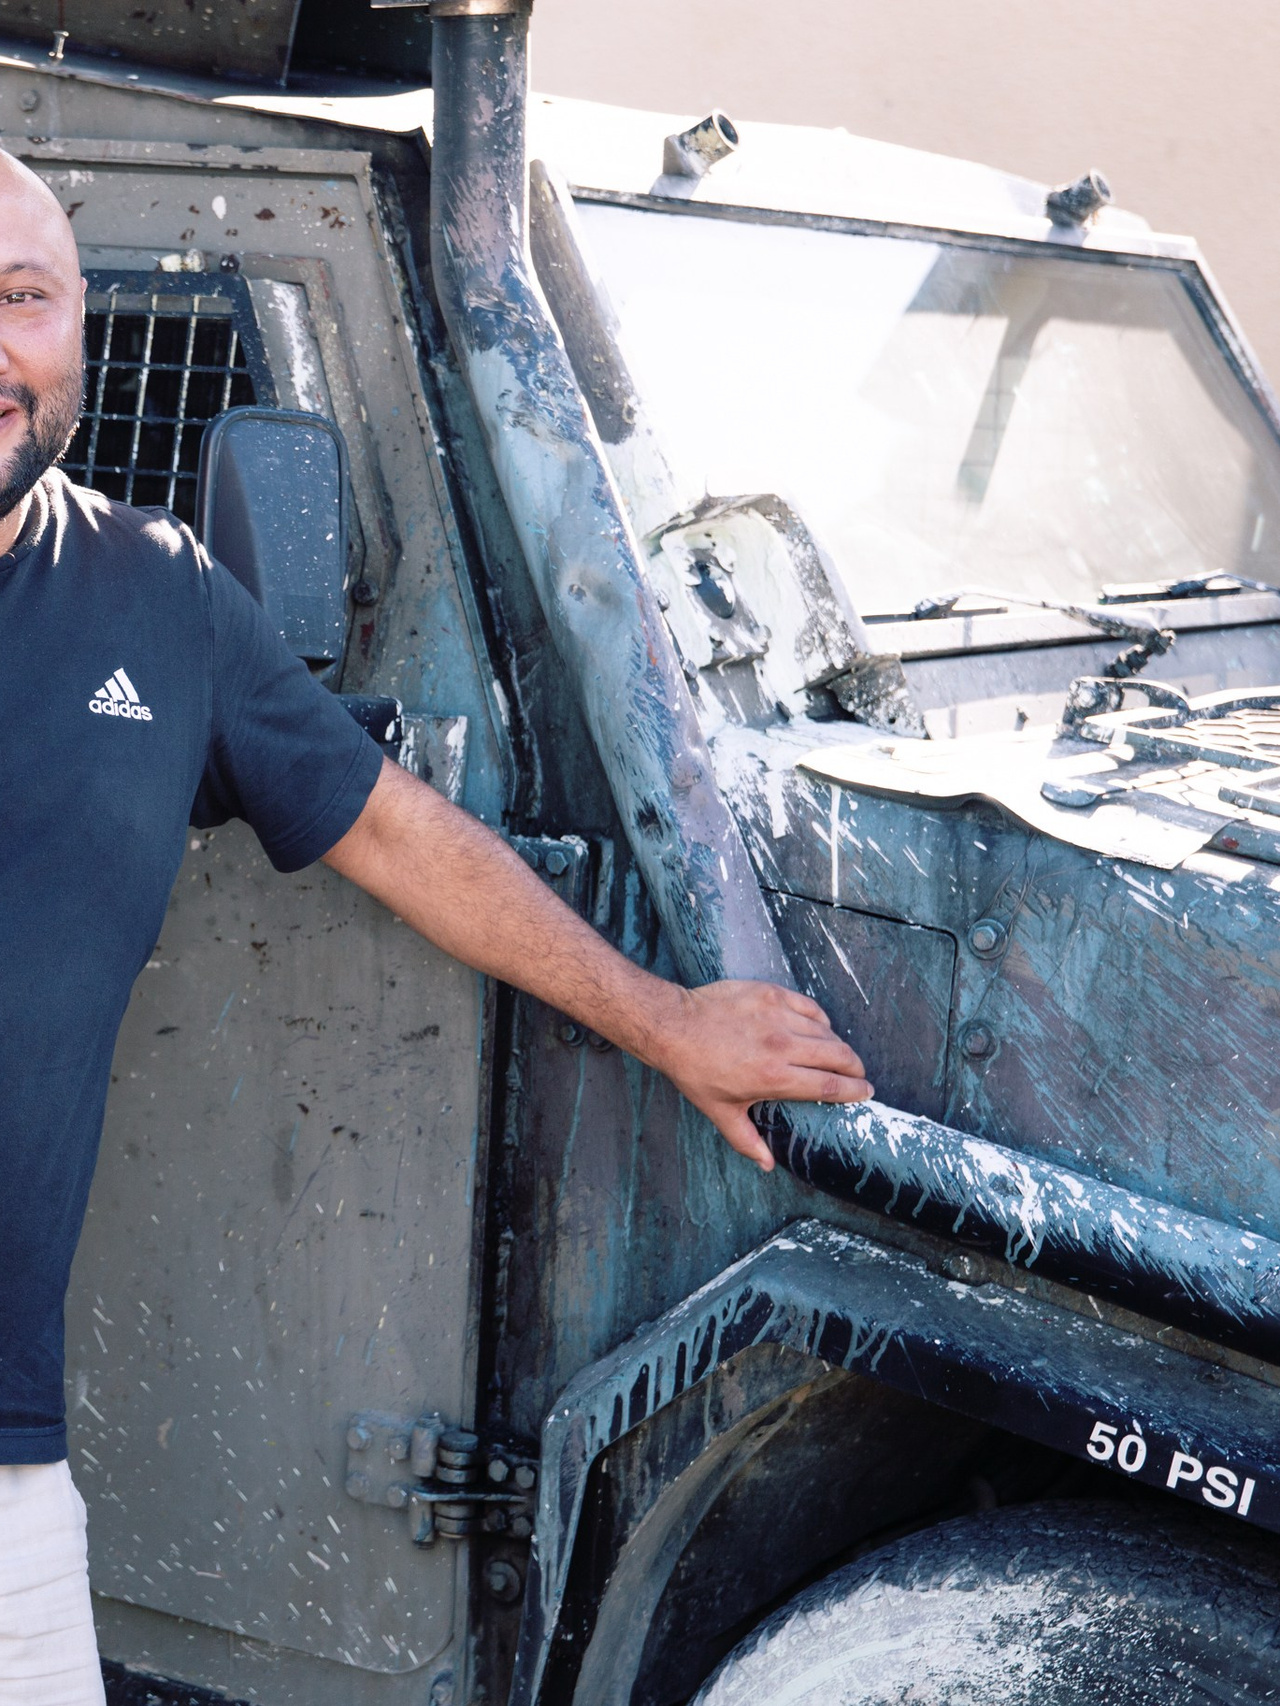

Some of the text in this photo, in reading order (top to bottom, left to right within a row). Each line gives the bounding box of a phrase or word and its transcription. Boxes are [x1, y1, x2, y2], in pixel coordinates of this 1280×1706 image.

[88, 697, 153, 721] adidas
[1086, 1420, 1256, 1516] 50 PSI
